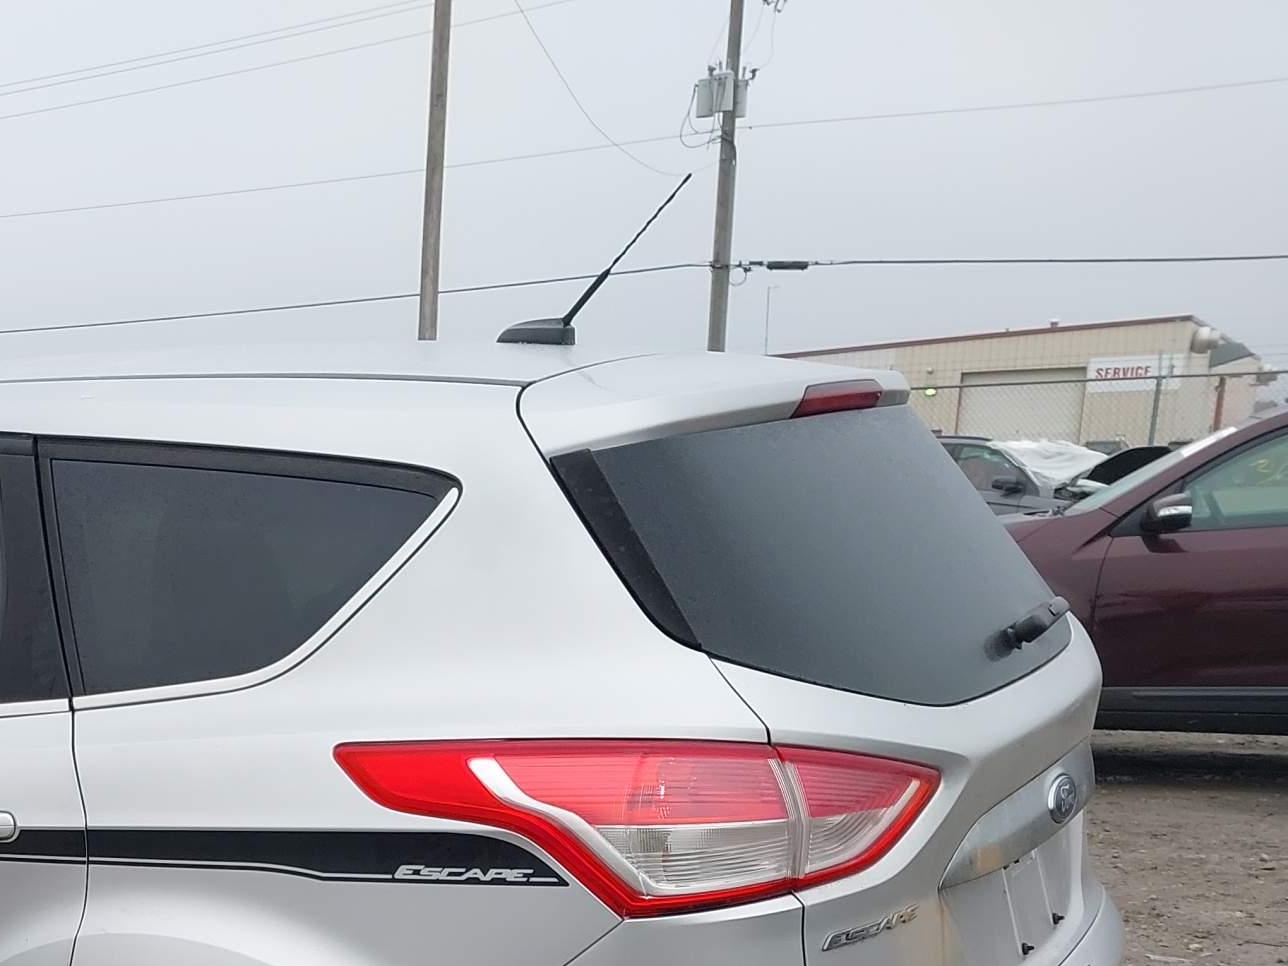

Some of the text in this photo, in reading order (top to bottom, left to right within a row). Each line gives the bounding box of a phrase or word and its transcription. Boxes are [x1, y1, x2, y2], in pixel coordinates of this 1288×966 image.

[1095, 365, 1152, 379] SERVICE
[393, 864, 534, 882] ESCAPE
[821, 904, 920, 951] ESCAPE
